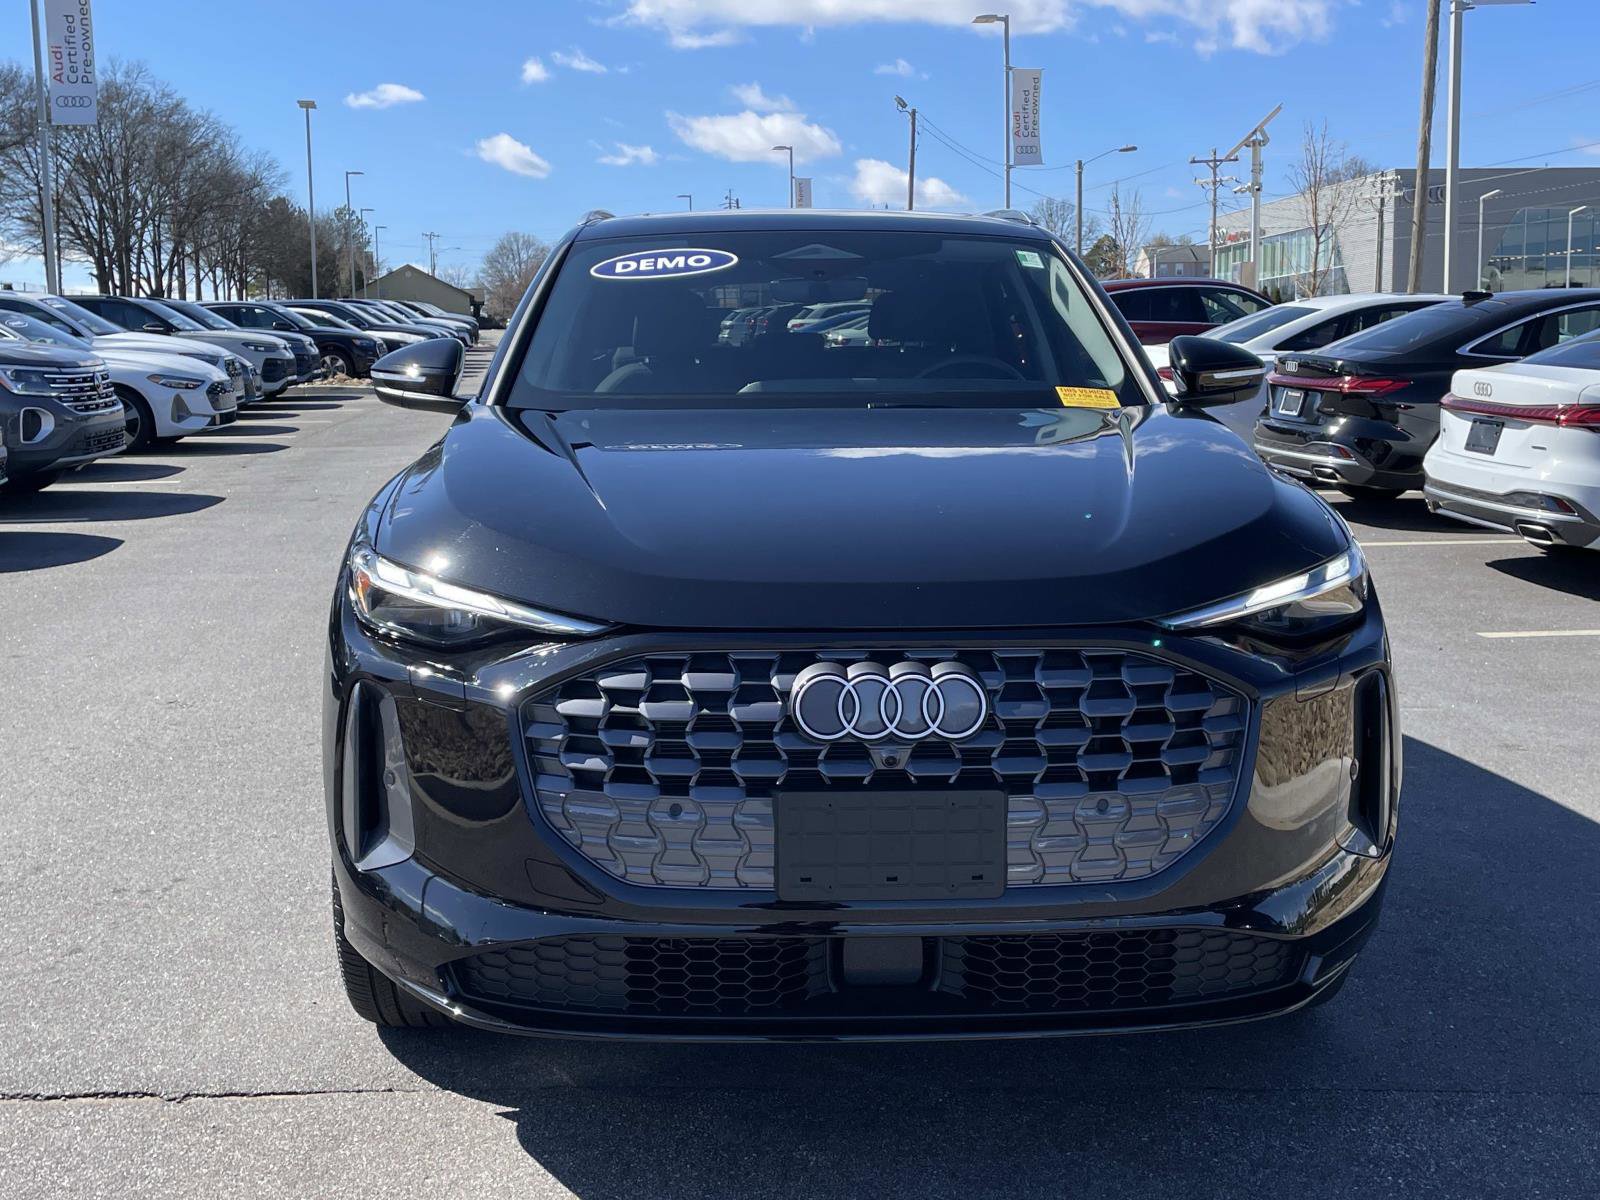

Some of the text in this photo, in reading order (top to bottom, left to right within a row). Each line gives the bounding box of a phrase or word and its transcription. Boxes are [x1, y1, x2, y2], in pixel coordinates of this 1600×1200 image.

[51, 46, 64, 85] Audi
[64, 14, 78, 84] Certified
[1013, 111, 1021, 138] Audi
[1022, 89, 1030, 138] Certified
[1031, 77, 1040, 138] Pre-owned
[614, 255, 711, 273] DEMO
